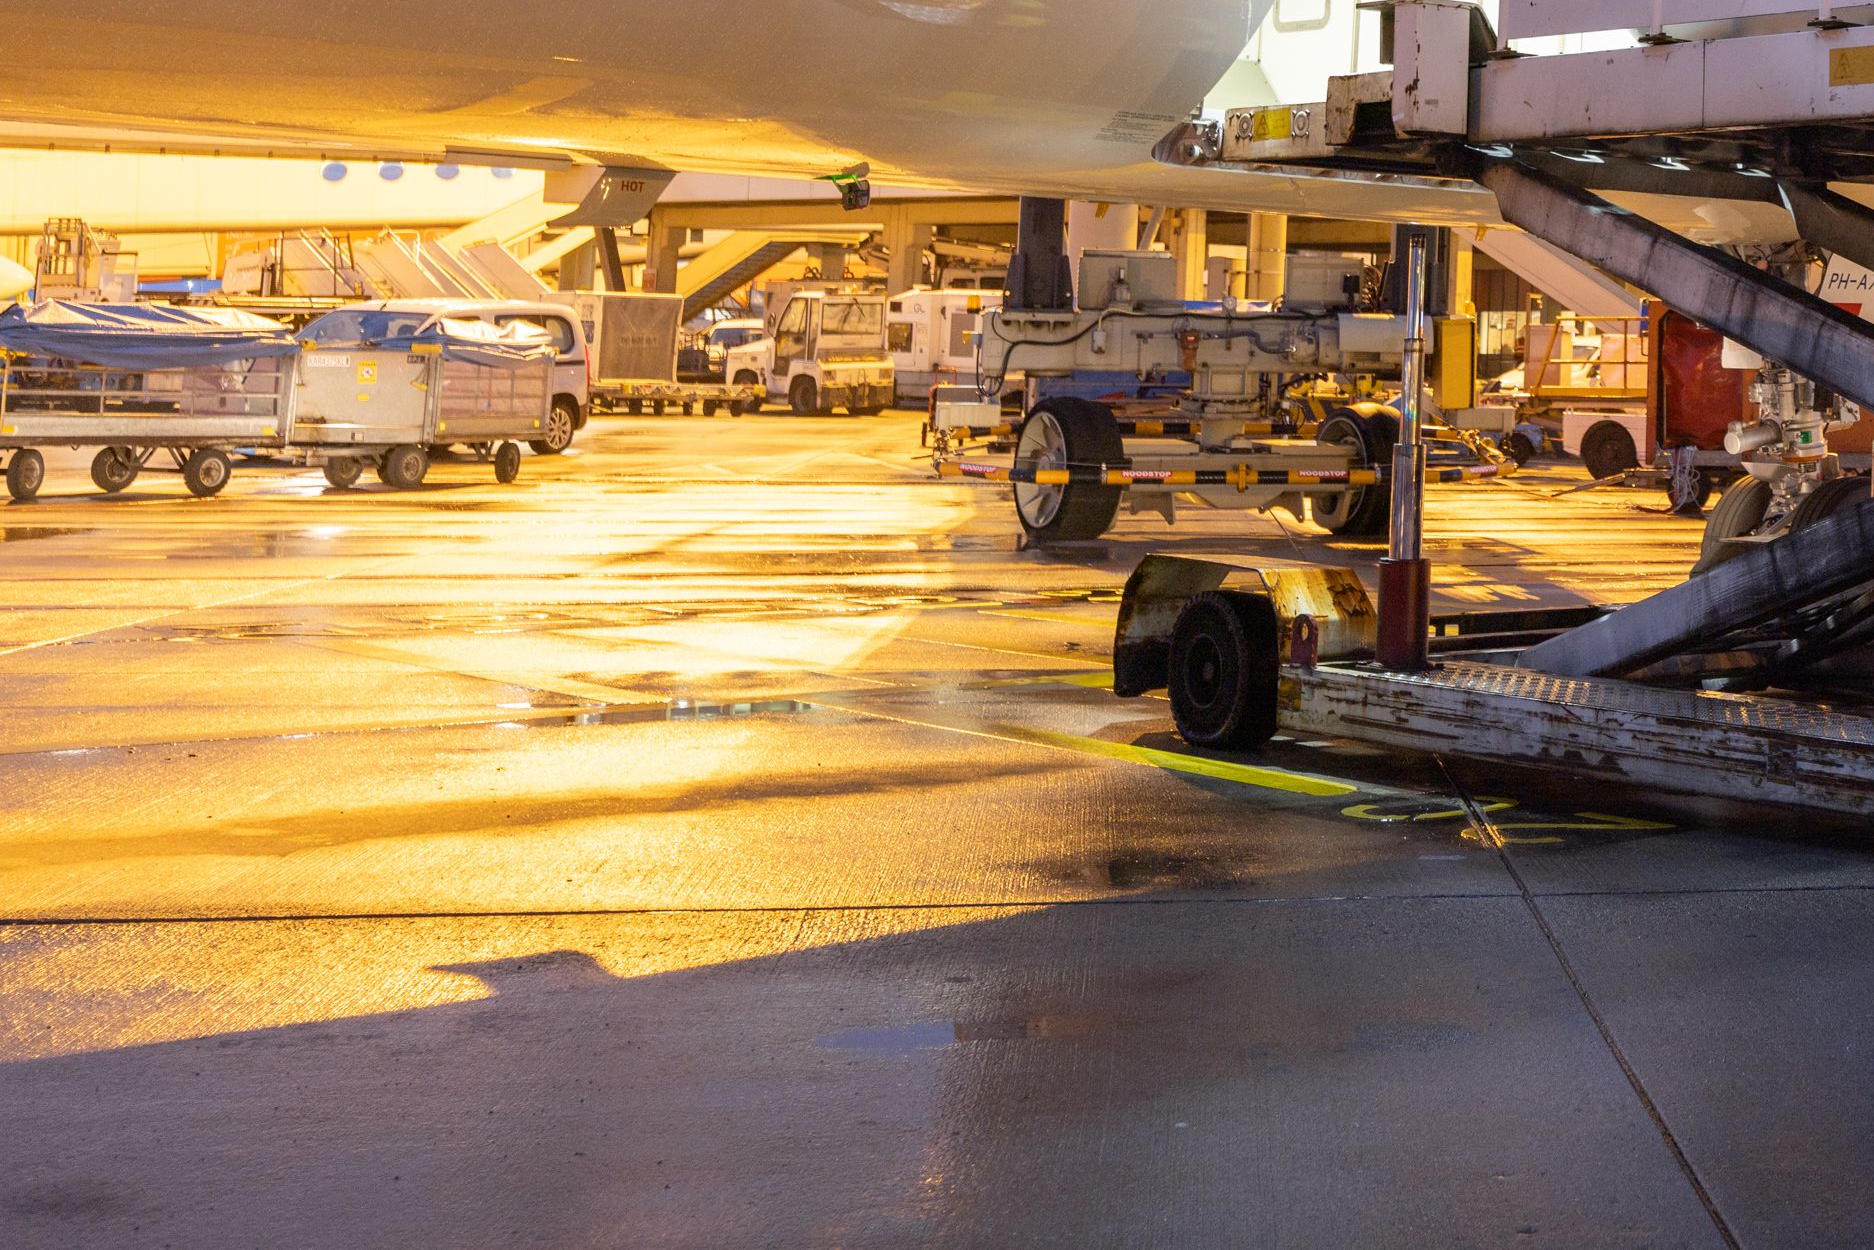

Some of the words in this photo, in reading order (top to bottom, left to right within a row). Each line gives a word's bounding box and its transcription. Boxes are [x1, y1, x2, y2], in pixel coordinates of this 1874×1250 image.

[621, 180, 645, 192] HOT
[1122, 470, 1172, 478] NOODSTOP
[1299, 469, 1347, 478] NOODSTOP
